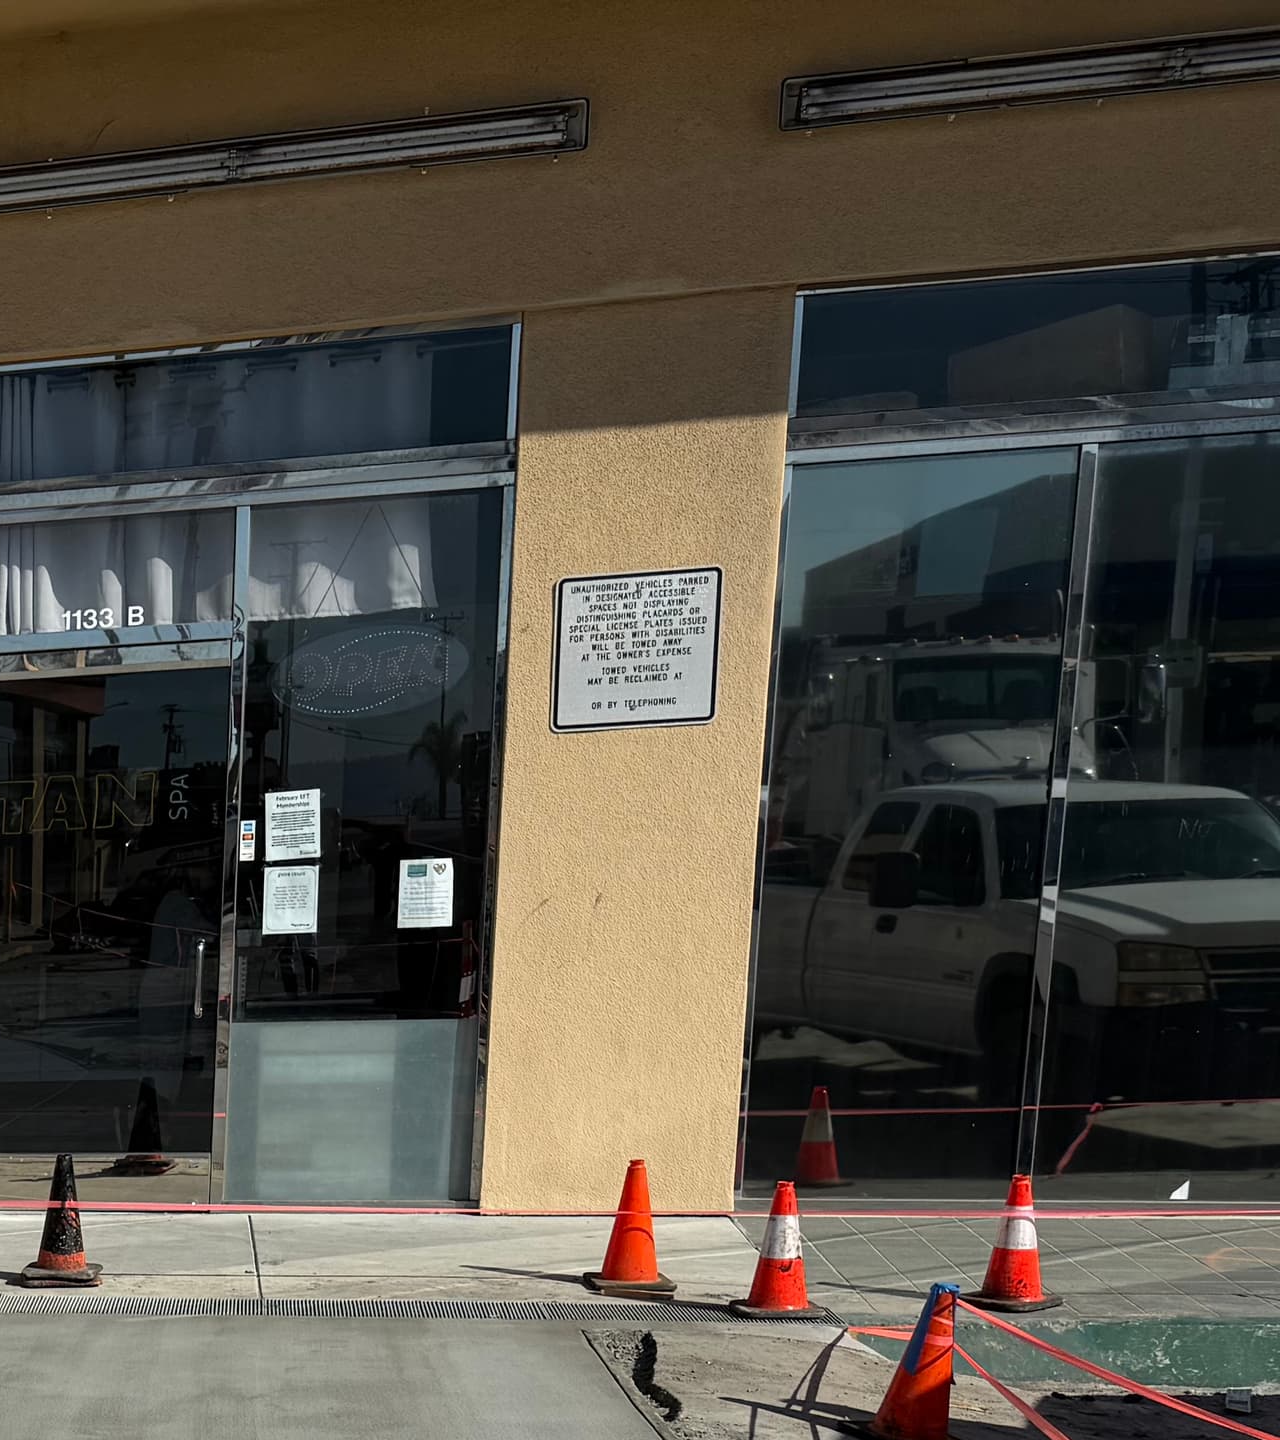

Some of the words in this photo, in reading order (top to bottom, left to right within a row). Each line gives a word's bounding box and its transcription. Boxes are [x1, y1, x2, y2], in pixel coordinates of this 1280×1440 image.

[571, 583, 629, 594] UNAUTHORIZED
[635, 578, 672, 590] VEHICLES
[679, 576, 709, 585] PARKED
[583, 595, 590, 603] IN
[596, 592, 641, 602] DESIGNATED
[649, 587, 695, 597] ACCESSIBLE
[590, 604, 616, 612] SPACES
[623, 602, 636, 610] NOT
[644, 599, 689, 608] DISPLAYING
[62, 608, 114, 630] 1133
[128, 606, 144, 626] B
[577, 612, 636, 623] DISTINGUISHING
[643, 608, 683, 618] PLACARDS
[690, 607, 700, 615] OR
[569, 625, 600, 633] SPECIAL
[607, 621, 638, 631] LICENSE
[645, 619, 673, 628] PLATES
[679, 617, 707, 625] ISSUED
[570, 635, 584, 643] FOR
[590, 632, 625, 641] PERSONS
[632, 630, 649, 638] WITH
[656, 626, 705, 637] DISABILITIES
[592, 643, 608, 651] WILL
[632, 640, 656, 648] TOWED
[663, 638, 682, 646] AWAY
[582, 654, 589, 662] AT
[617, 650, 650, 659] OWNER'S
[657, 647, 692, 656] EXPENSE
[288, 644, 449, 701] OPEN
[602, 666, 626, 675] TOWED
[633, 663, 670, 672] VEHICLES
[588, 678, 602, 686] MAY
[625, 673, 667, 683] RECLAIMED
[674, 672, 682, 680] AT
[592, 702, 601, 710] OR
[608, 701, 617, 709] BY
[625, 697, 676, 708] TELEPHONING
[168, 773, 190, 821] SPA
